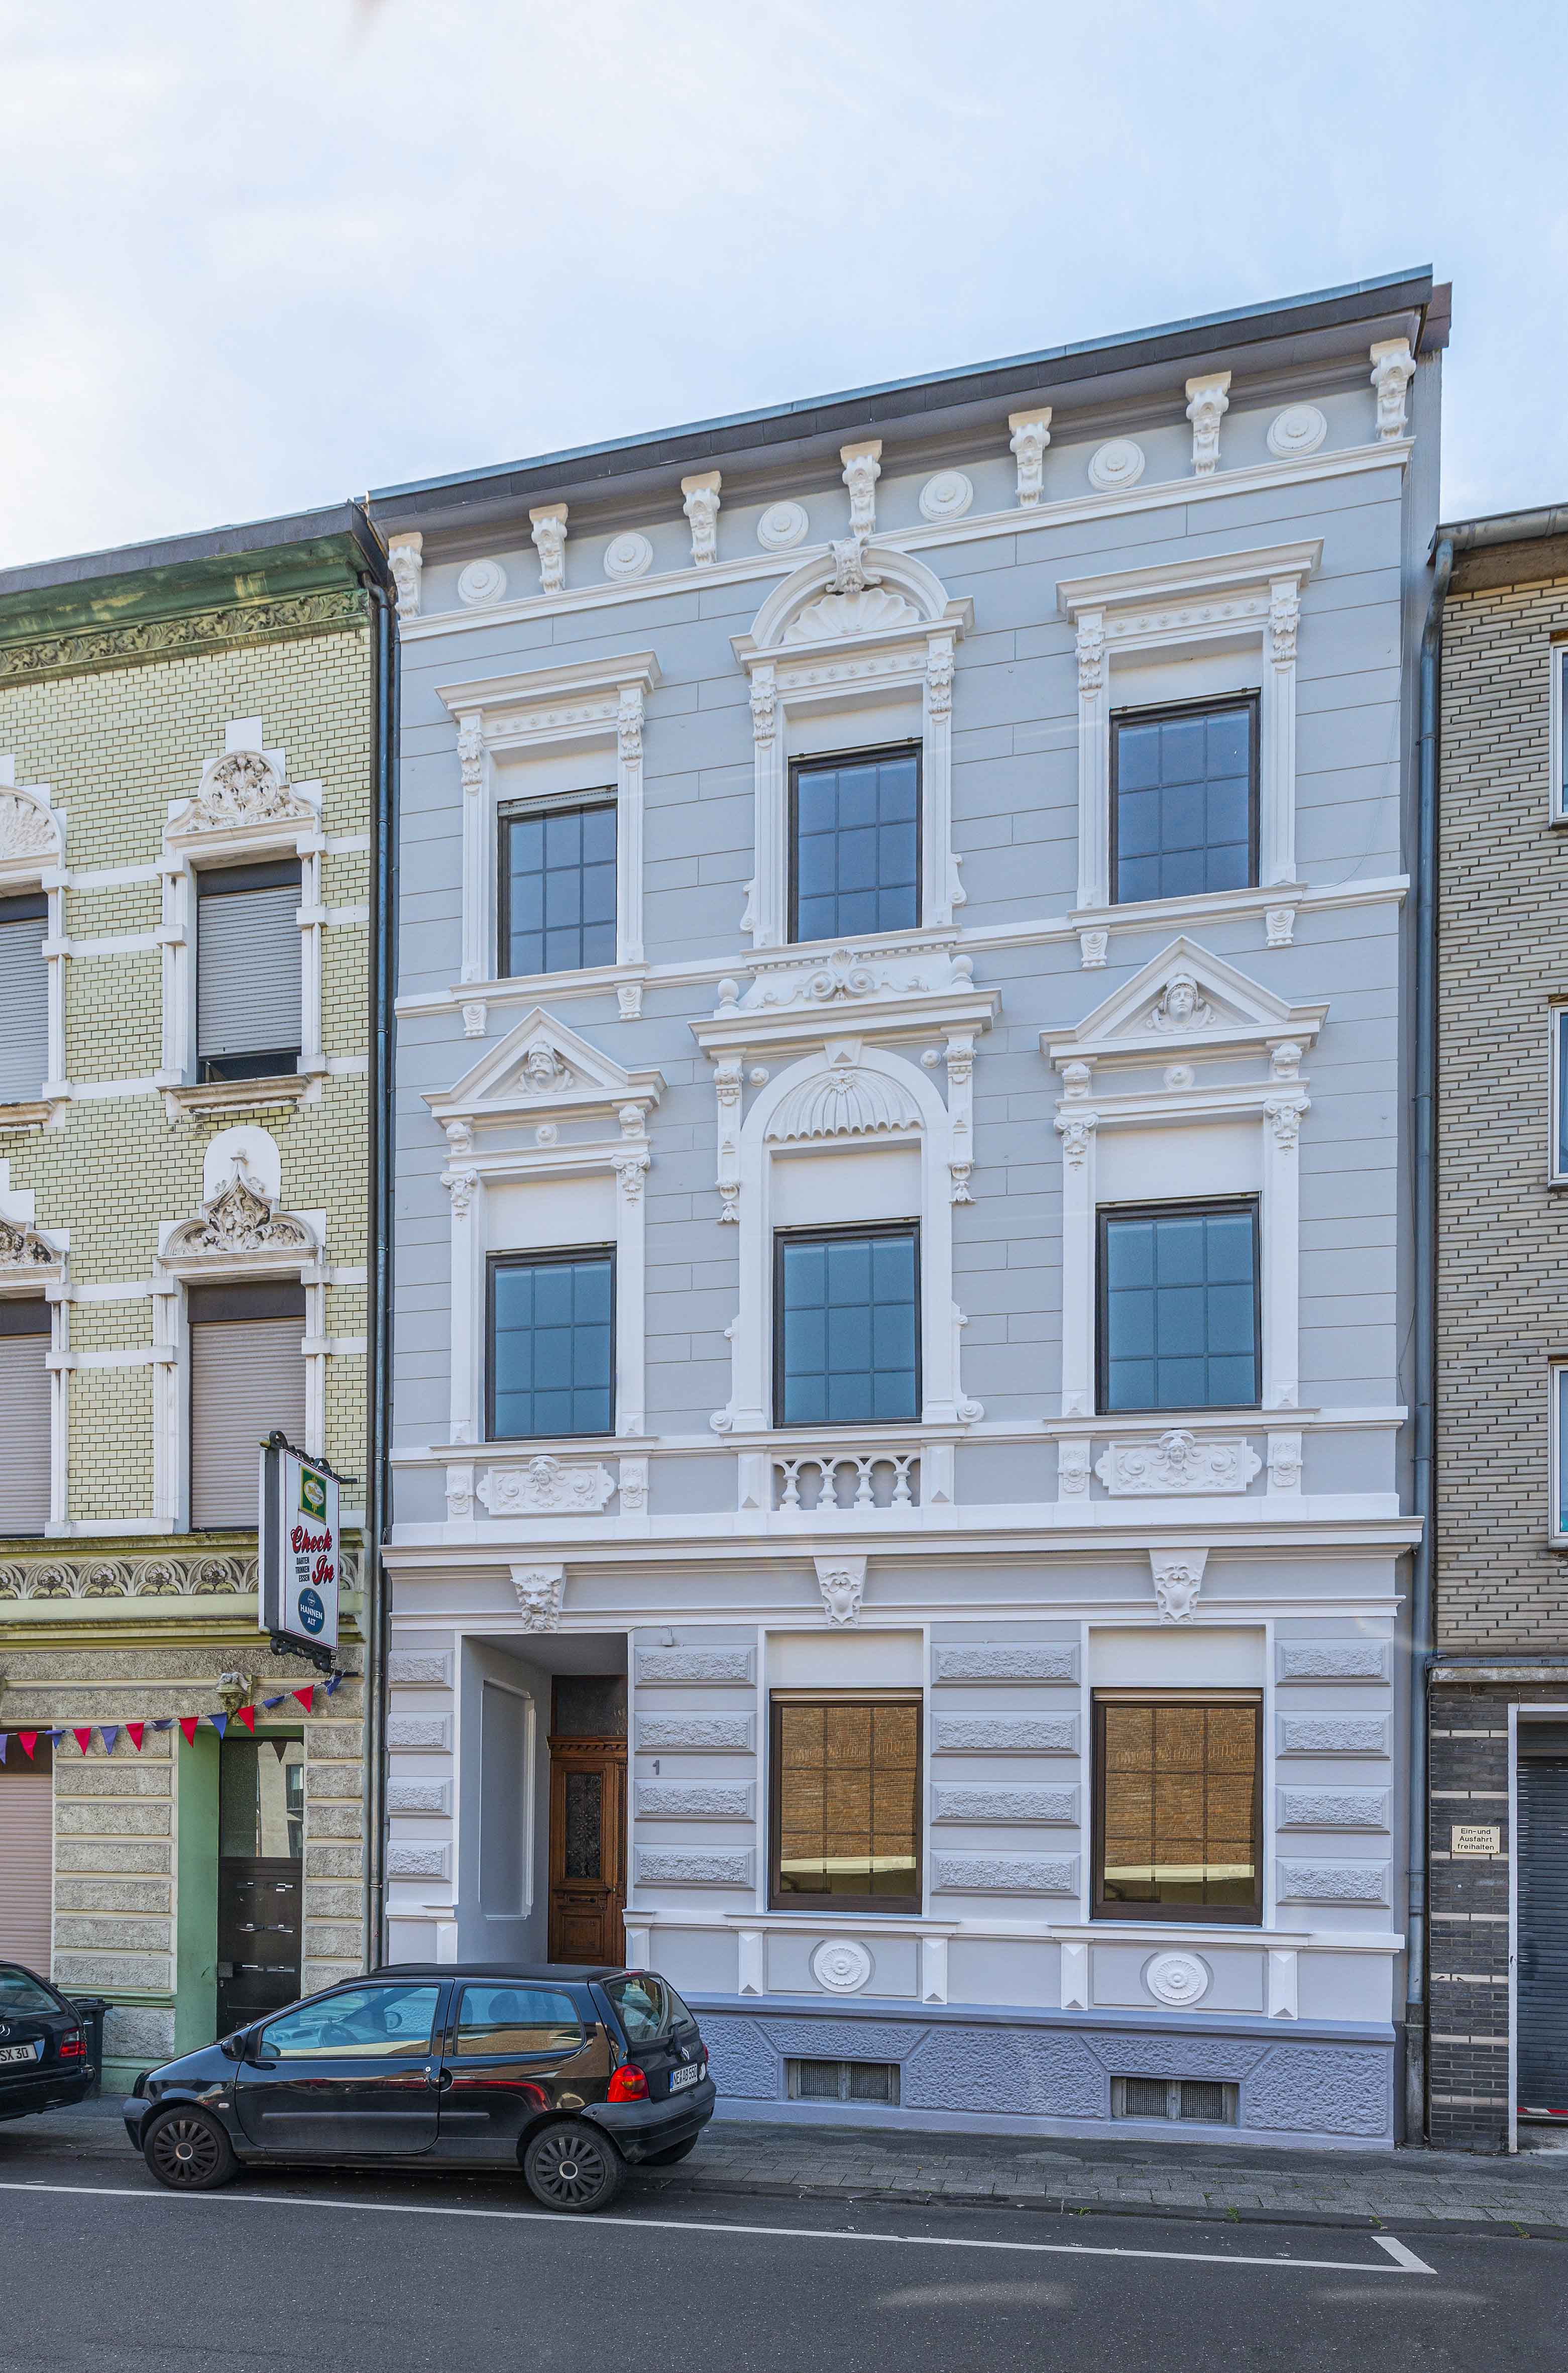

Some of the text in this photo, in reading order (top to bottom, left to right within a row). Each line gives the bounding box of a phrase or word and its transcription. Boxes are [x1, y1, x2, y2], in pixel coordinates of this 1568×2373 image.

[290, 1525, 332, 1554] Check
[295, 1565, 310, 1574] TRINKEN
[312, 1555, 334, 1586] In
[299, 1574, 310, 1582] ESSEN
[300, 1604, 322, 1620] HANNEN
[307, 1617, 316, 1626] ALT
[652, 1760, 659, 1775] 1
[0, 2047, 29, 2061] SX 30
[673, 2072, 680, 2086] NE
[682, 2069, 689, 2082] AB
